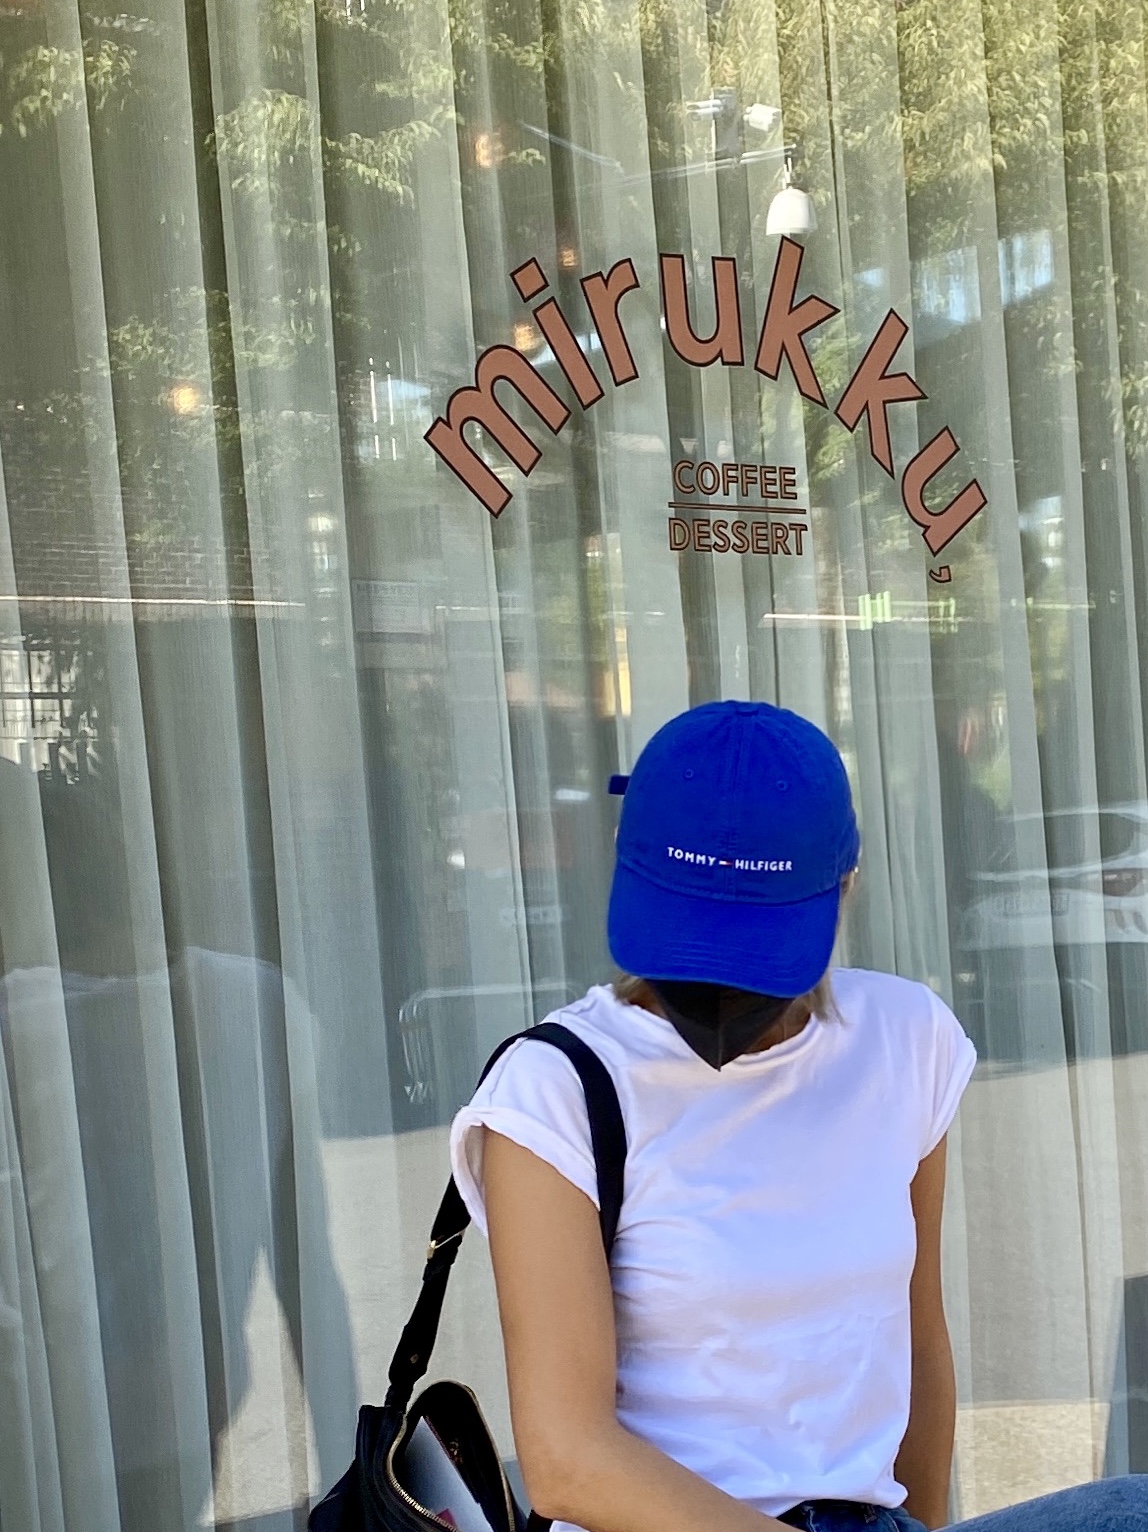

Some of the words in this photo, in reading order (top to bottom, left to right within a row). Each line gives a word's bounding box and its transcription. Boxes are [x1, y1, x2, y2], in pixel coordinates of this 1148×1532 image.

[673, 459, 798, 500] COFFEE
[668, 517, 808, 556] DESSERT
[667, 846, 717, 867] TOMMY
[734, 859, 793, 871] HILFIGER
